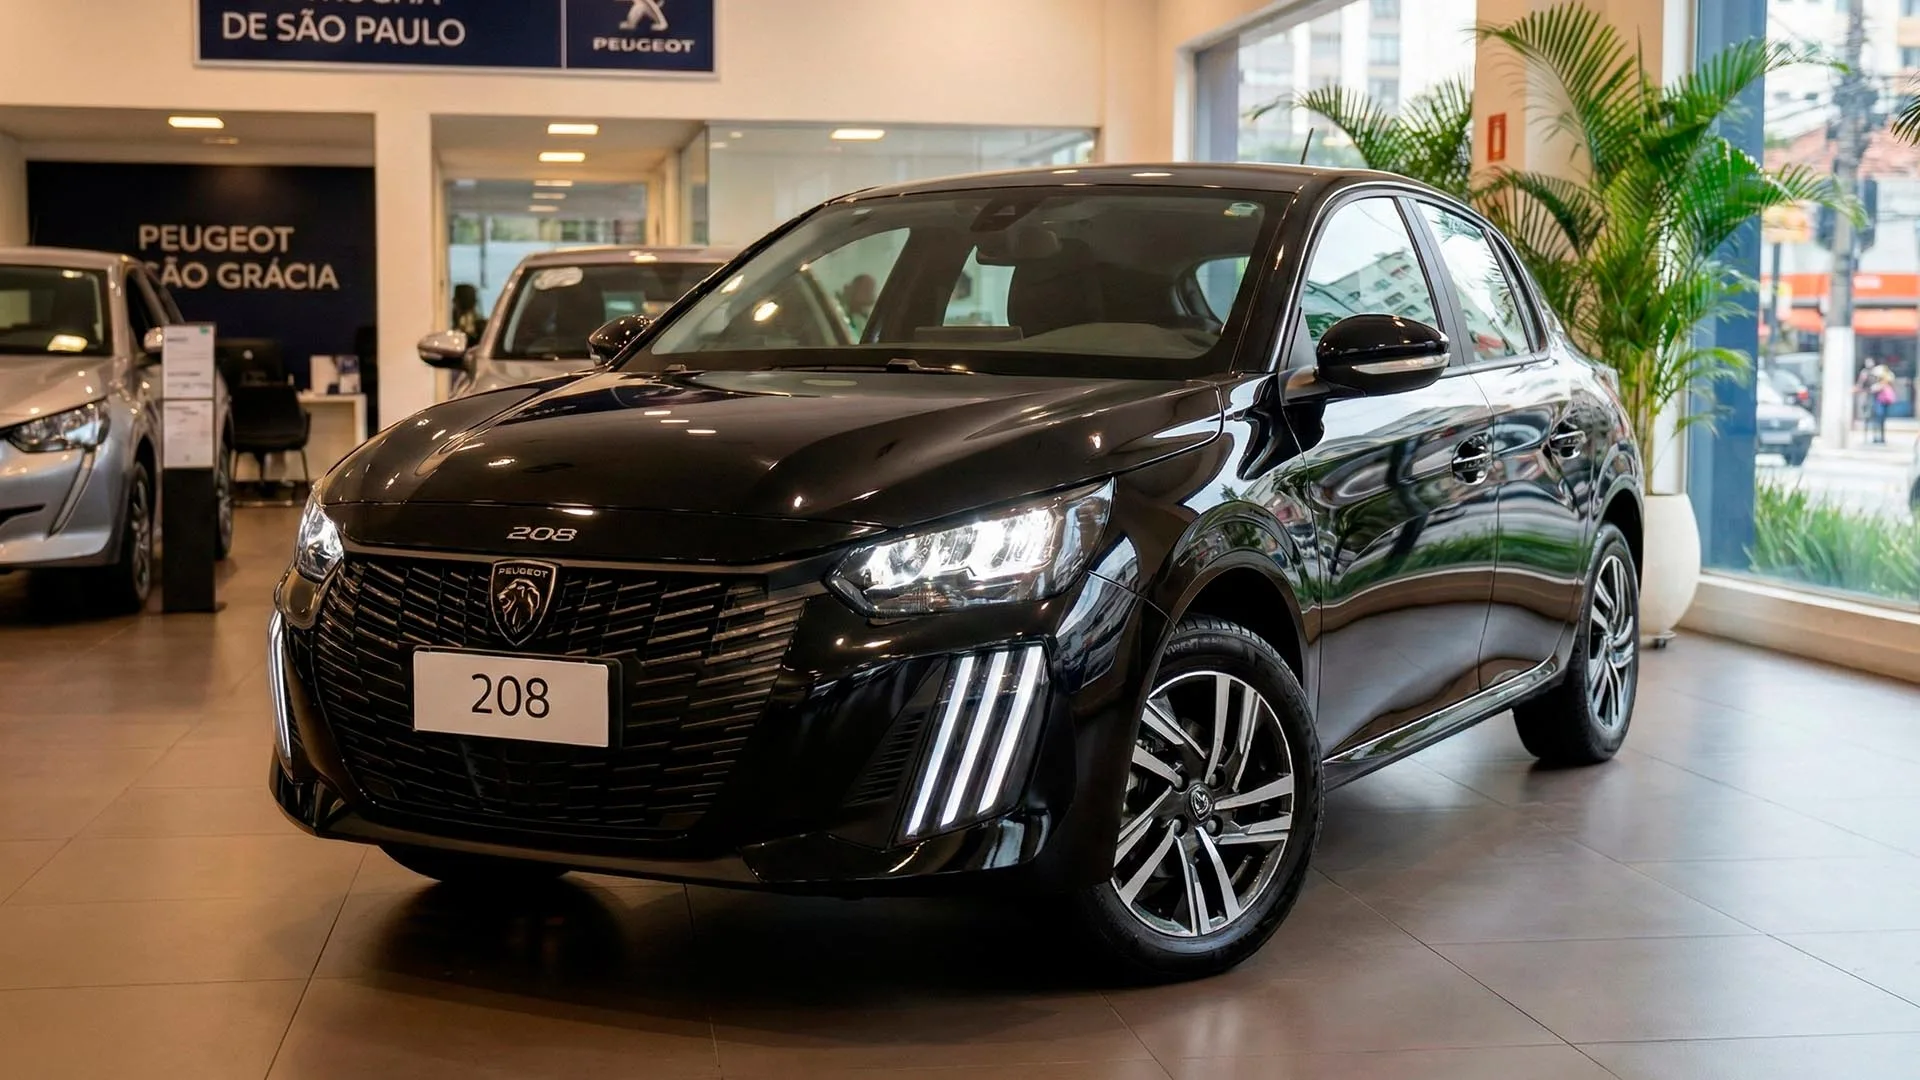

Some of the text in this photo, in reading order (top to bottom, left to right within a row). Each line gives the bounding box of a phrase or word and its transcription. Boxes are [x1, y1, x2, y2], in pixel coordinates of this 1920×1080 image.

[222, 9, 466, 46] DE SÃO PAULO
[592, 37, 695, 53] PEUGEOT
[138, 224, 295, 253] PEUGEOT
[216, 256, 340, 290] GRÁCIA
[506, 526, 578, 542] 208
[498, 567, 549, 578] PEUGEOT
[471, 673, 550, 719] 208
